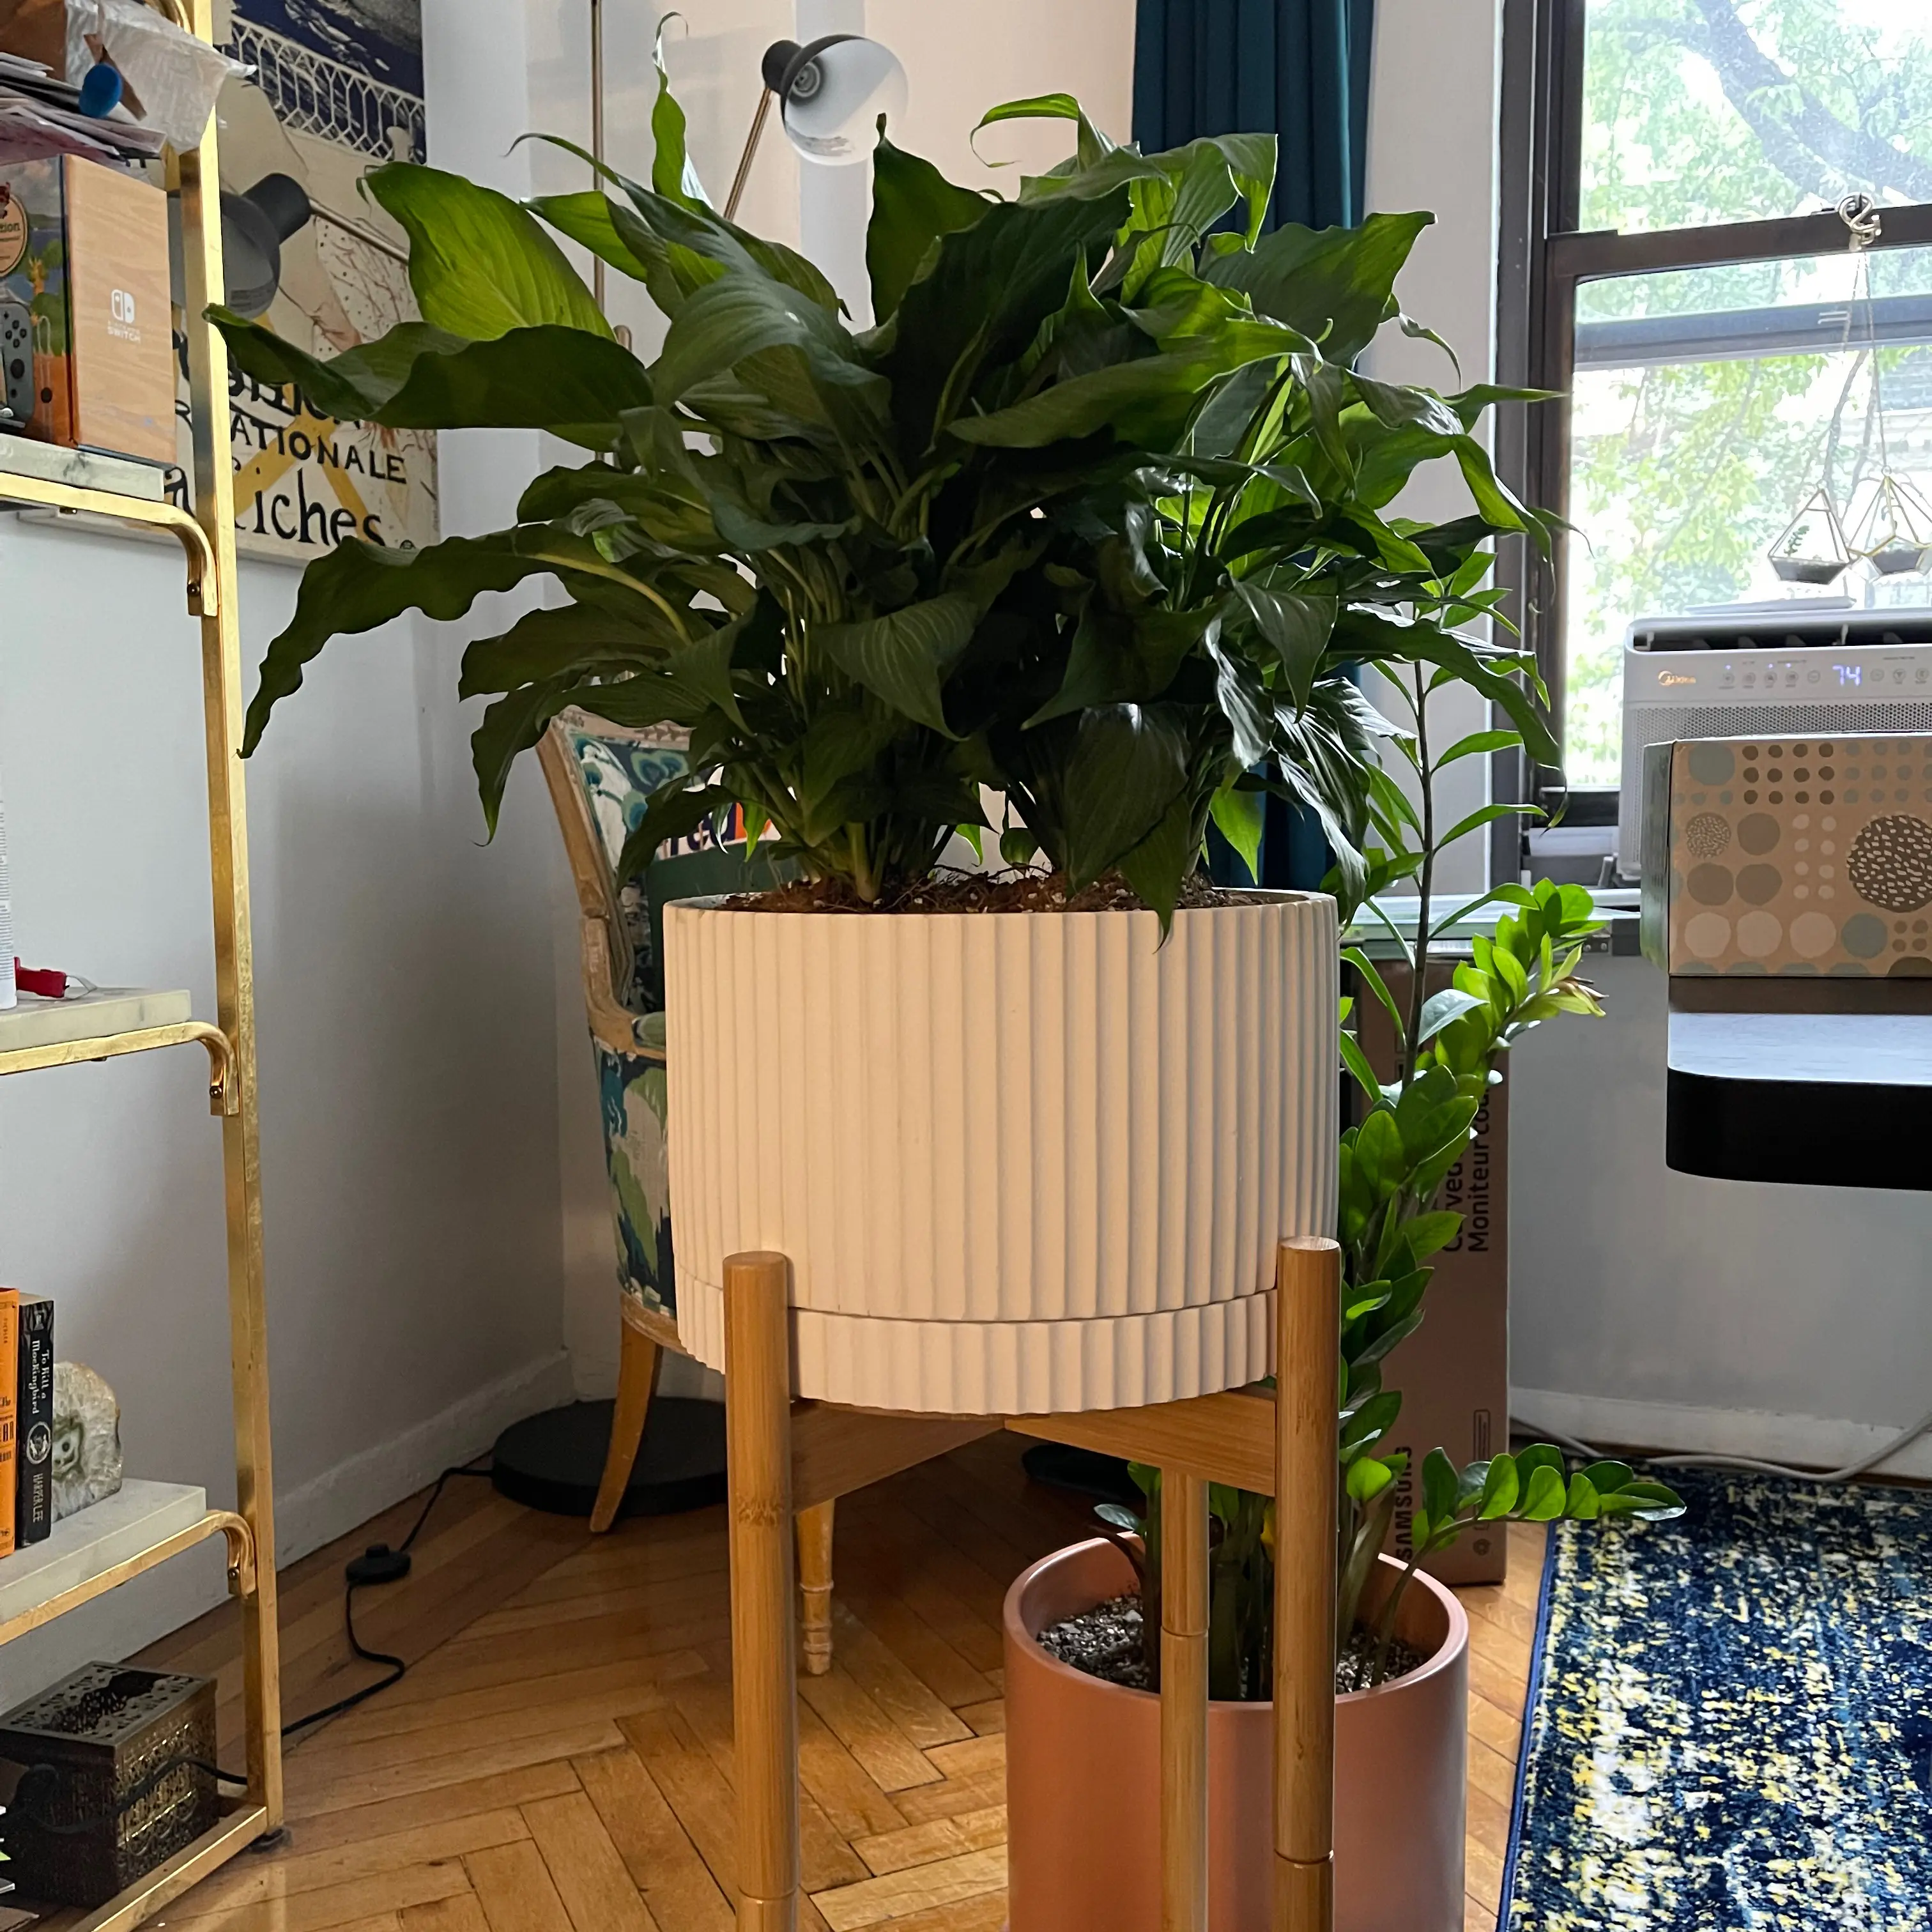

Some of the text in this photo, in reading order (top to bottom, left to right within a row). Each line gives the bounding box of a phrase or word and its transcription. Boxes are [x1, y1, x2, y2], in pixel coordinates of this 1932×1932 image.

[231, 412, 407, 484] ATIONALE
[234, 468, 385, 548] iches
[1832, 664, 1862, 686] 74
[1468, 1140, 1489, 1252] Moniteur
[28, 1339, 41, 1414] Mockingbird
[41, 1367, 50, 1390] Kill
[42, 1349, 50, 1364] To
[33, 1473, 43, 1523] HARPER LEE
